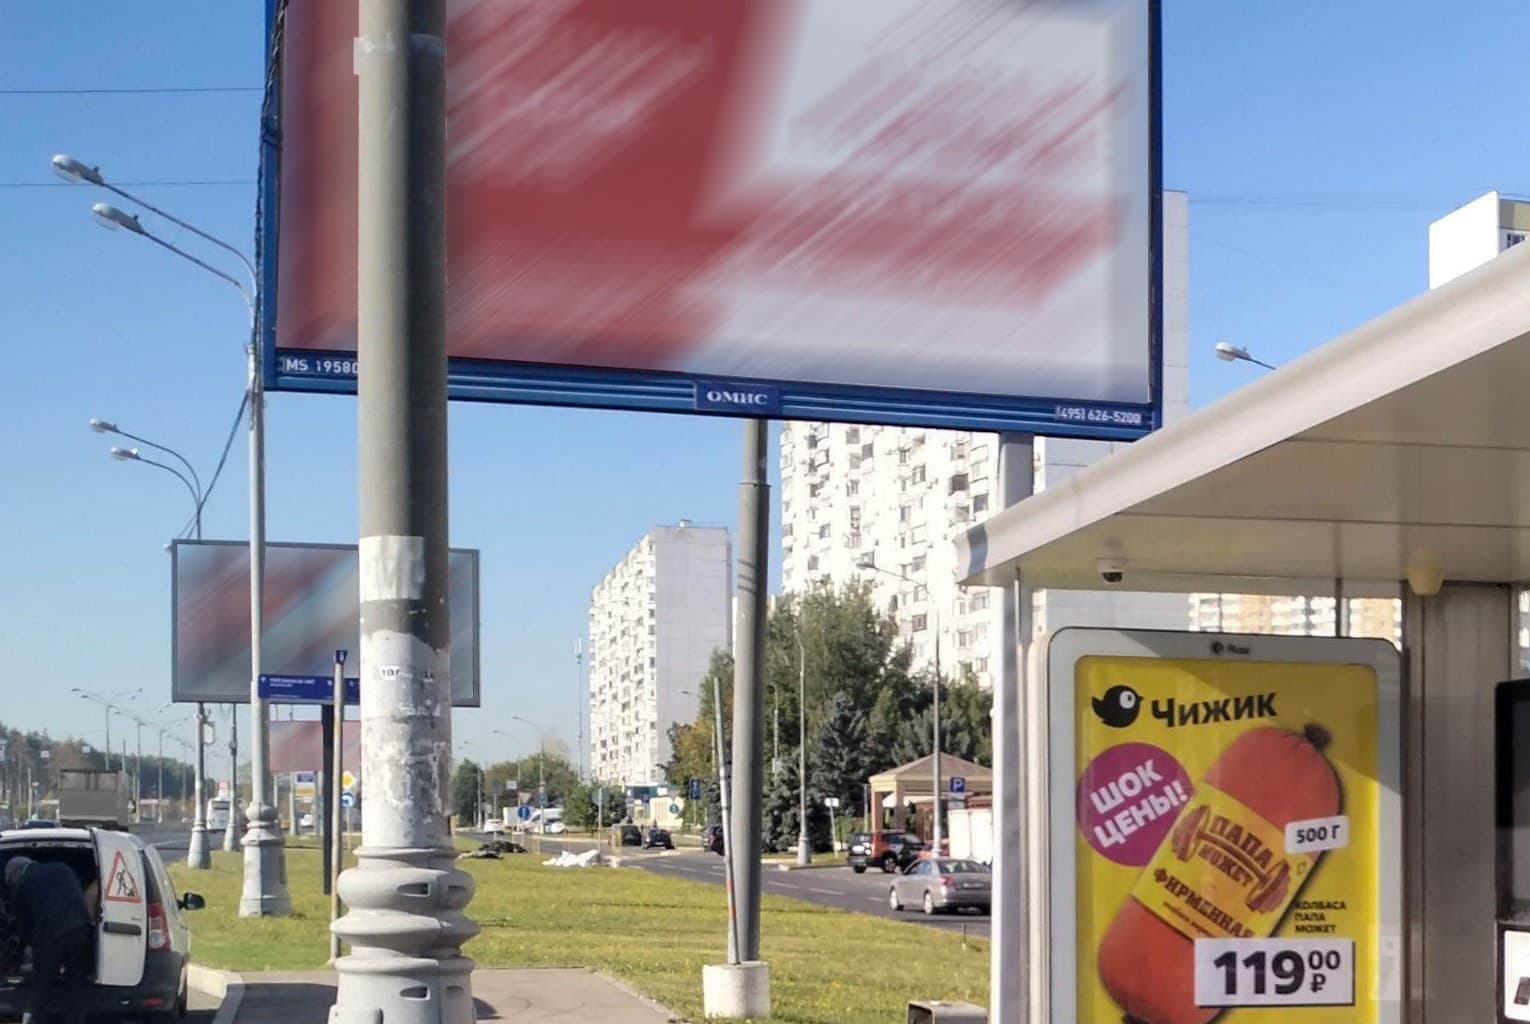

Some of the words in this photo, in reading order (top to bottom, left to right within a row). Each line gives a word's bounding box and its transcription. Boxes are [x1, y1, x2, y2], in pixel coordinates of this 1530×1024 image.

[286, 358, 309, 372] MS
[1089, 759, 1164, 815] ШОК
[1093, 780, 1188, 849] ЦЕНЫ!
[1296, 826, 1328, 845] 500
[1209, 815, 1273, 871] ПАПА
[1213, 950, 1305, 995] 119
[1307, 950, 1340, 970] 00
